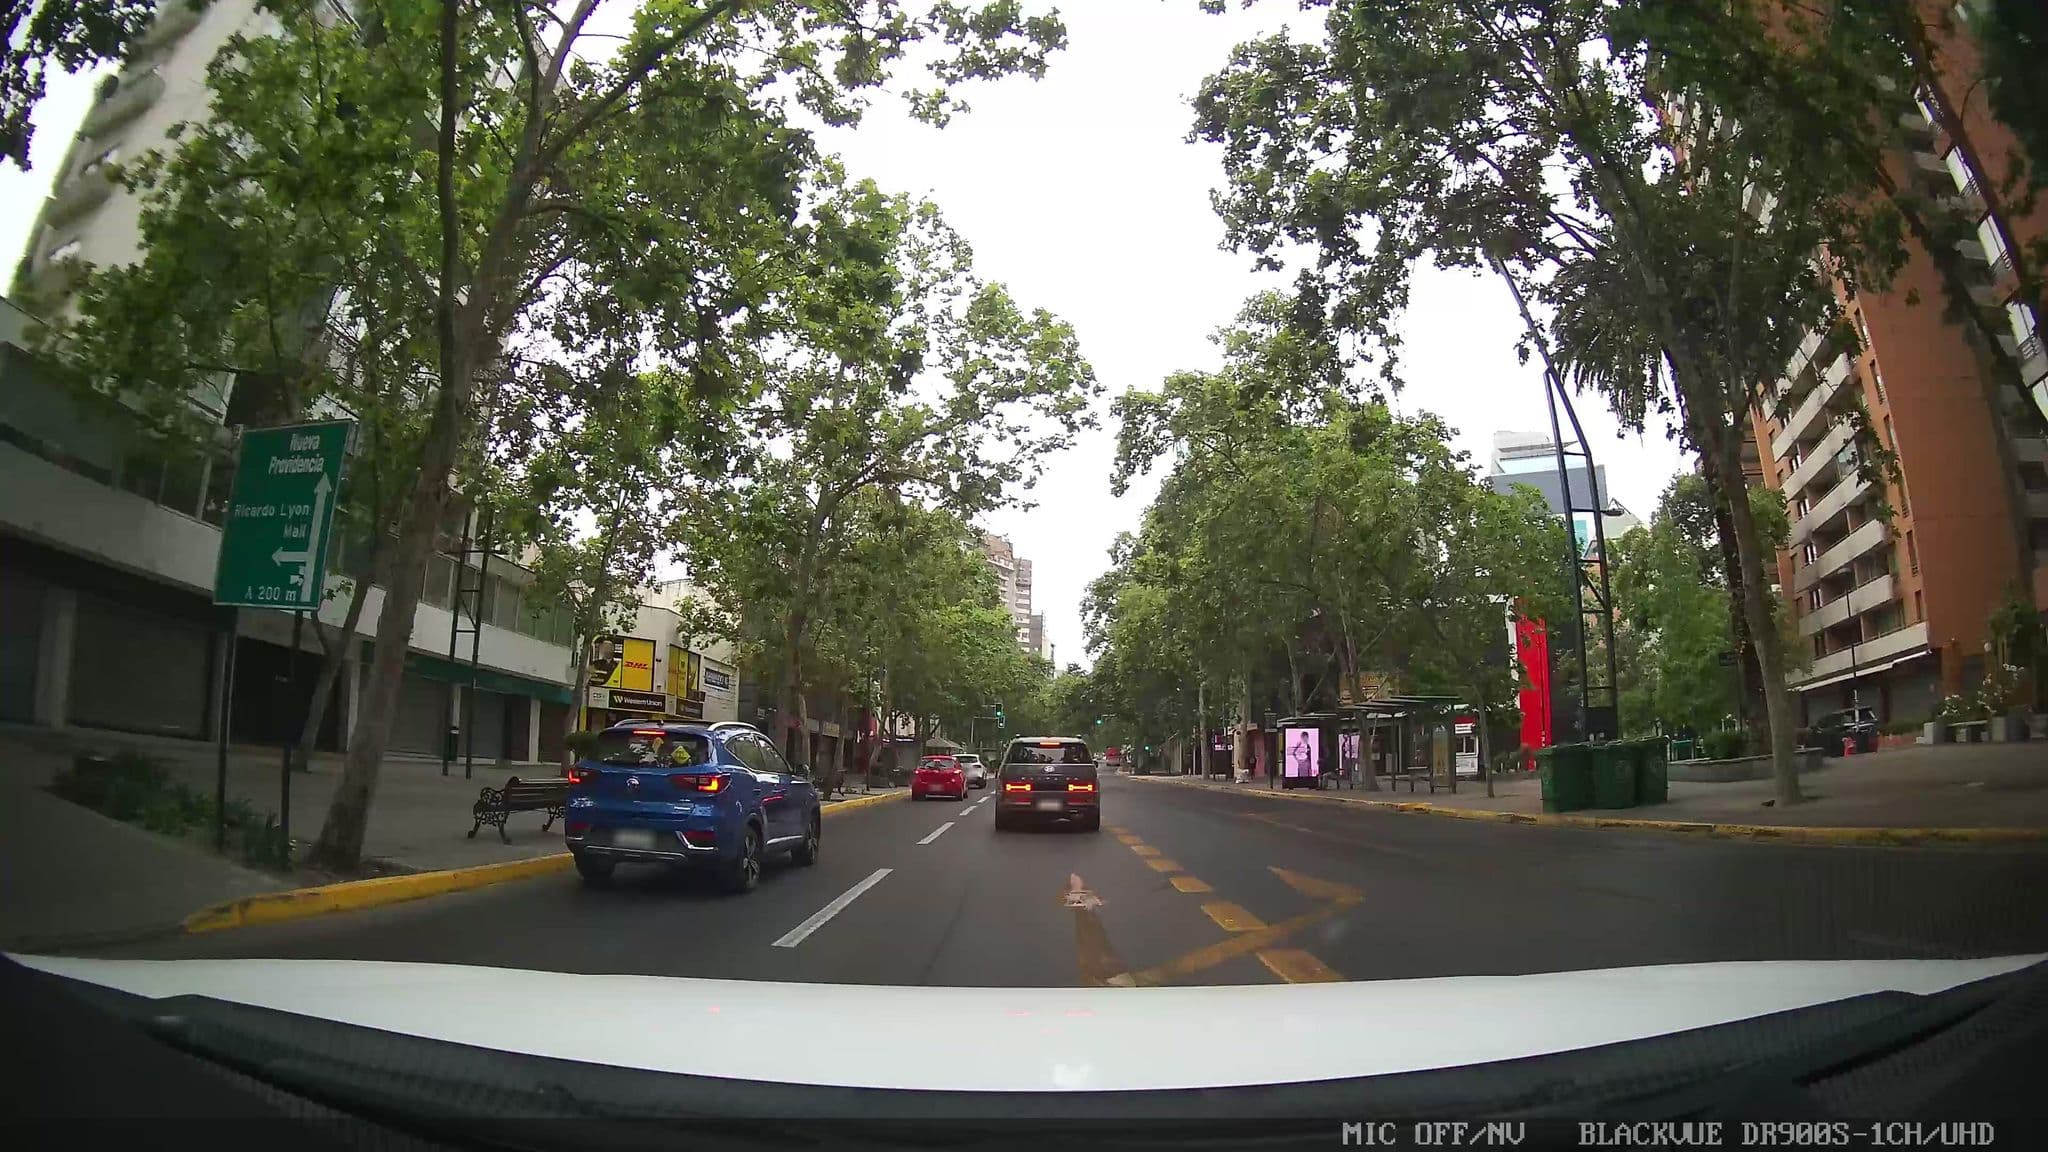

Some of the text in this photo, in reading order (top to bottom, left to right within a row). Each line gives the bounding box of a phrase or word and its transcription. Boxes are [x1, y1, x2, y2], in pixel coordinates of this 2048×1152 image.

[289, 433, 320, 451] Nueva
[268, 454, 324, 475] Providencia
[234, 503, 310, 519] Ricardo Lyon
[283, 524, 307, 538] Mall
[245, 586, 297, 601] A 200 m
[624, 661, 649, 670] DHL
